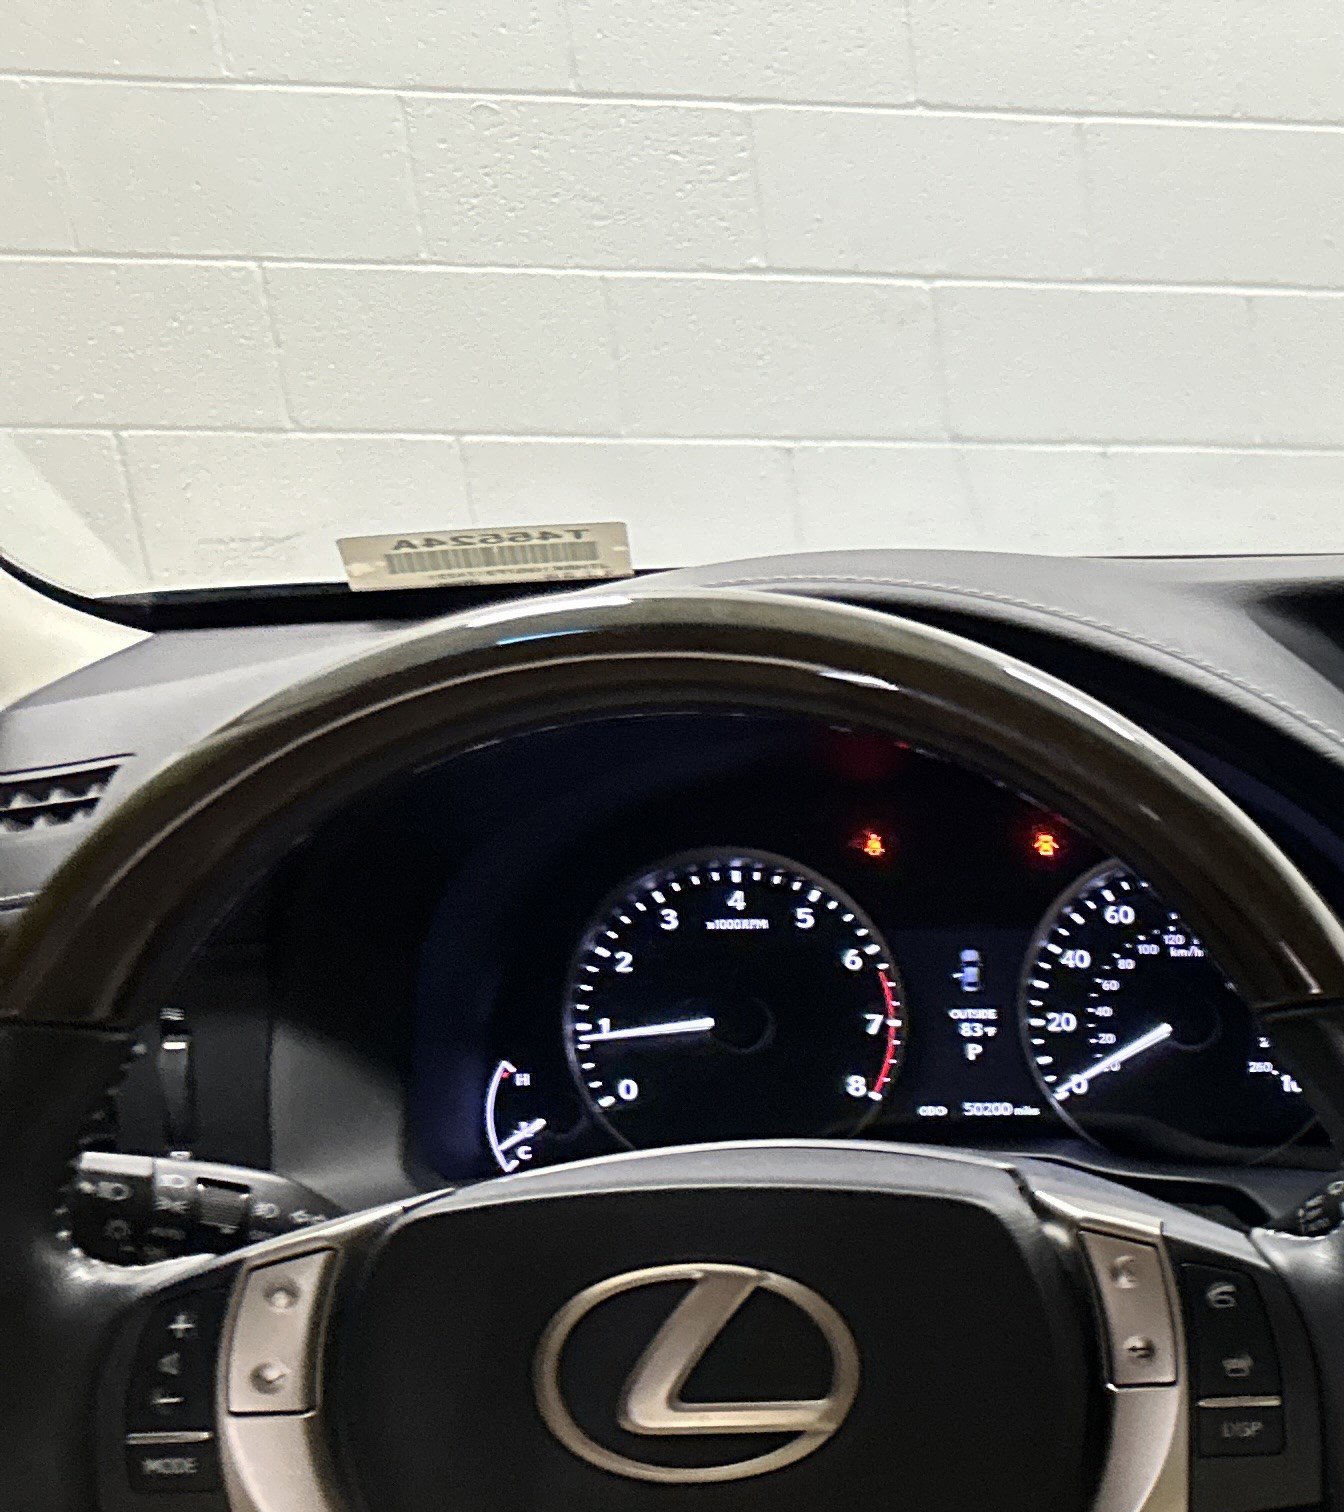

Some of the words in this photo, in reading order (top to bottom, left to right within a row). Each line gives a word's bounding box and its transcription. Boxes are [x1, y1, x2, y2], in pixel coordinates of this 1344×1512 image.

[727, 890, 747, 911] 4
[660, 909, 679, 931] 3
[795, 908, 815, 929] 5
[1103, 905, 1136, 925] 60
[1137, 944, 1160, 955] 100
[1162, 934, 1186, 945] 120
[615, 951, 634, 974] 2
[843, 950, 863, 971] 6
[1058, 950, 1092, 969] 40
[1117, 959, 1137, 970] 80
[1101, 980, 1121, 991] 60
[599, 1017, 612, 1036] 1
[864, 1013, 885, 1035] 7
[1046, 1012, 1078, 1032] 20
[1098, 1033, 1117, 1044] 20
[966, 1043, 984, 1061] P
[515, 1073, 531, 1088] H
[618, 1079, 639, 1101] 0
[845, 1074, 867, 1097] 8
[1071, 1074, 1089, 1095] 0
[517, 1146, 533, 1160] C
